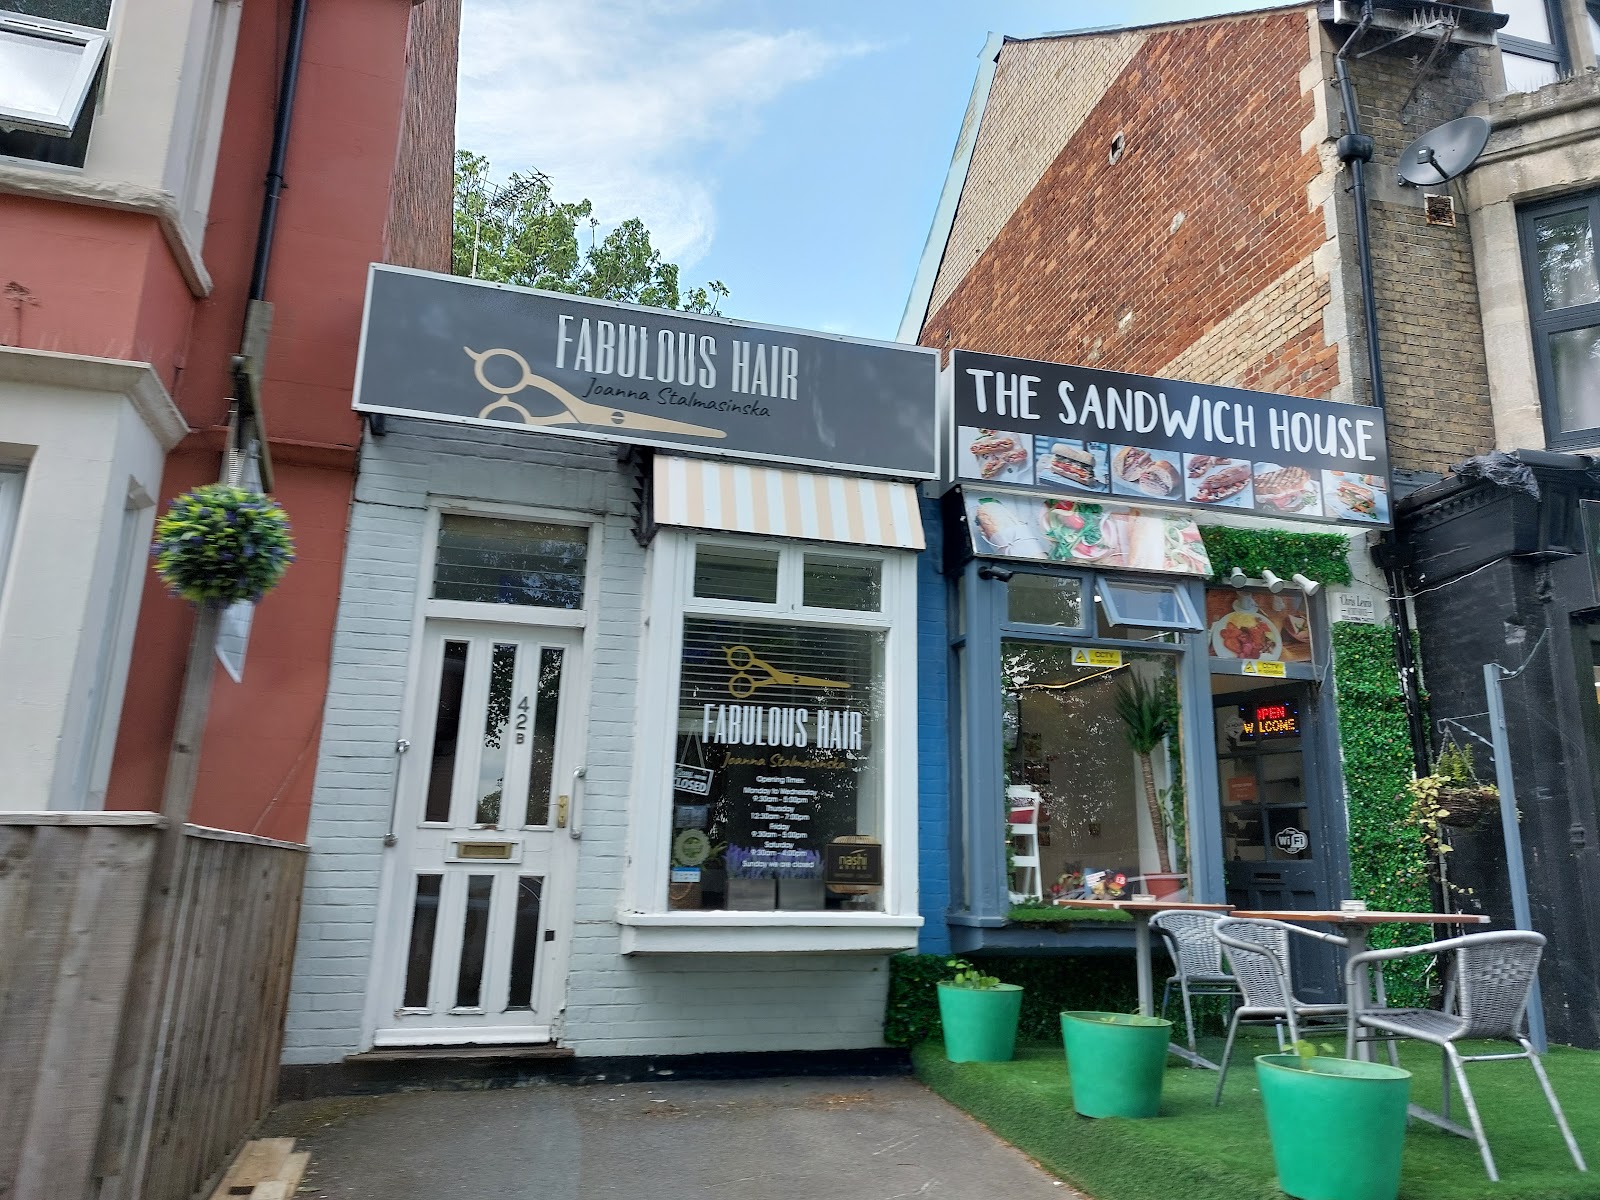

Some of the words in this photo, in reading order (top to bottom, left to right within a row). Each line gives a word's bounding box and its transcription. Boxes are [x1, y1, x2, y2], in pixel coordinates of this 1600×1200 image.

[555, 314, 717, 389] FABULOUS
[731, 339, 799, 401] HAIR
[582, 377, 650, 401] Joanna
[656, 387, 771, 417] Stalmasinska
[965, 368, 1041, 420] THE
[1056, 380, 1256, 448] SANDWICH
[1268, 407, 1377, 462] HOUSE
[1094, 651, 1115, 659] CCTV
[701, 703, 809, 748] FABULOUS
[816, 709, 863, 751] HAIR
[1243, 718, 1296, 734] WLCOME
[673, 777, 707, 792] LOSED
[755, 775, 785, 785] Opening
[838, 852, 868, 866] nashi
